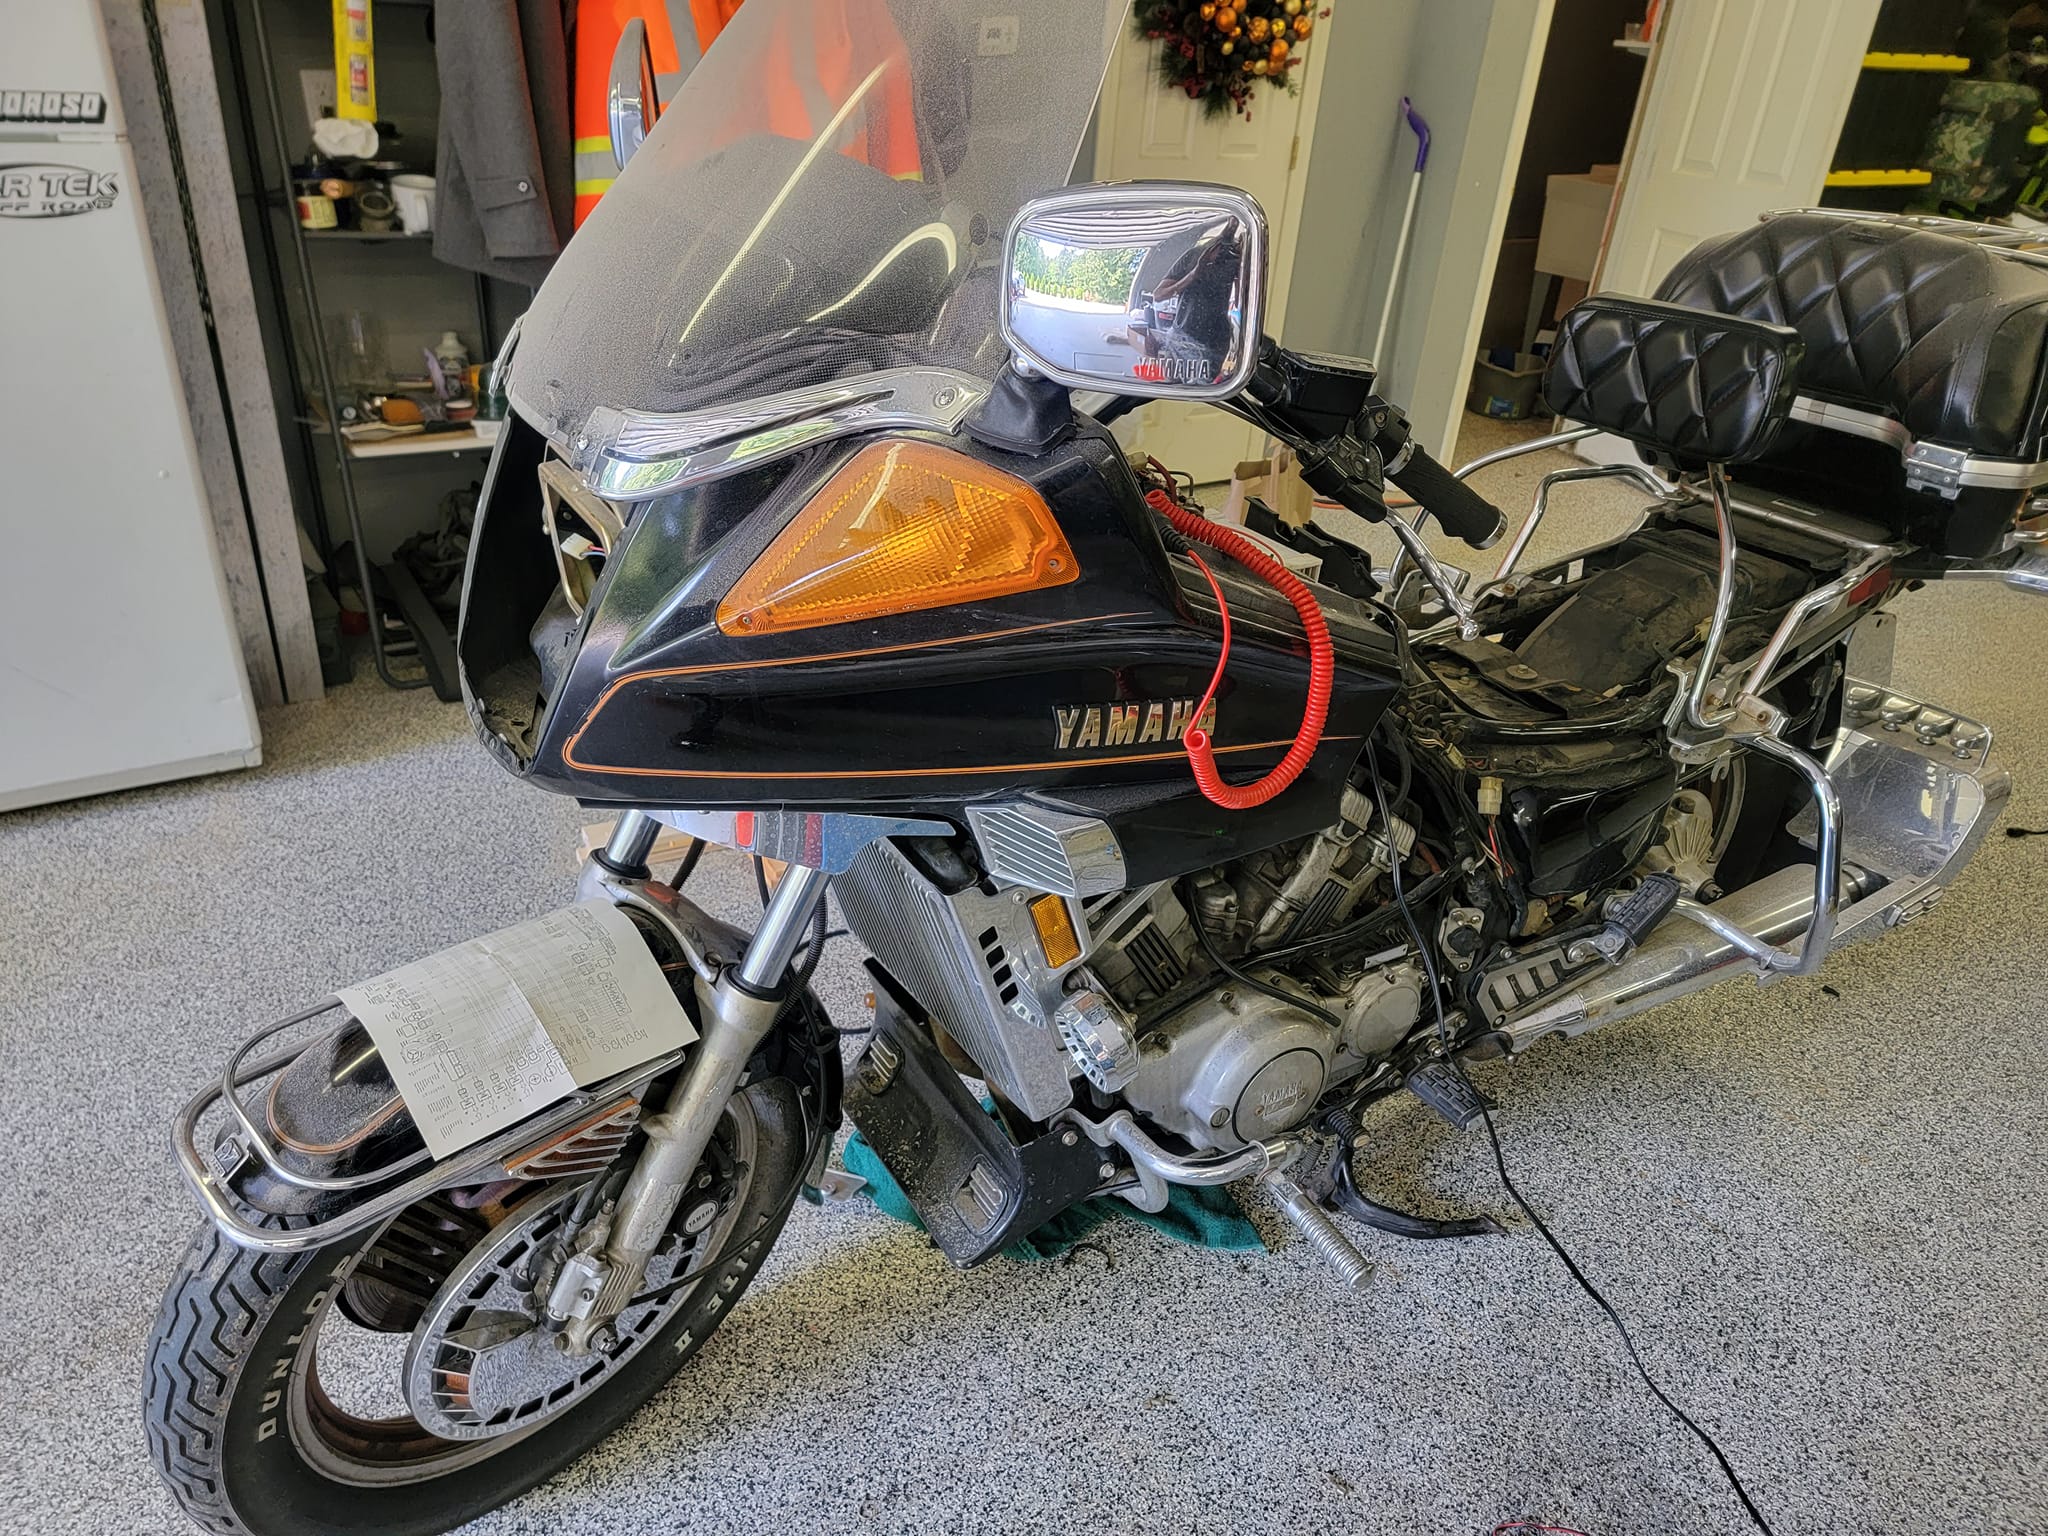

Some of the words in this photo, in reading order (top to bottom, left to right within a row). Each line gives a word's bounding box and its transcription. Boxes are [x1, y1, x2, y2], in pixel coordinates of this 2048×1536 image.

[0, 90, 107, 124] OROSO
[0, 173, 32, 198] R
[39, 172, 119, 201] TEK
[1136, 355, 1210, 380] YAMAHA
[688, 1207, 714, 1228] YAMAHA
[256, 1254, 352, 1442] DUNLOP
